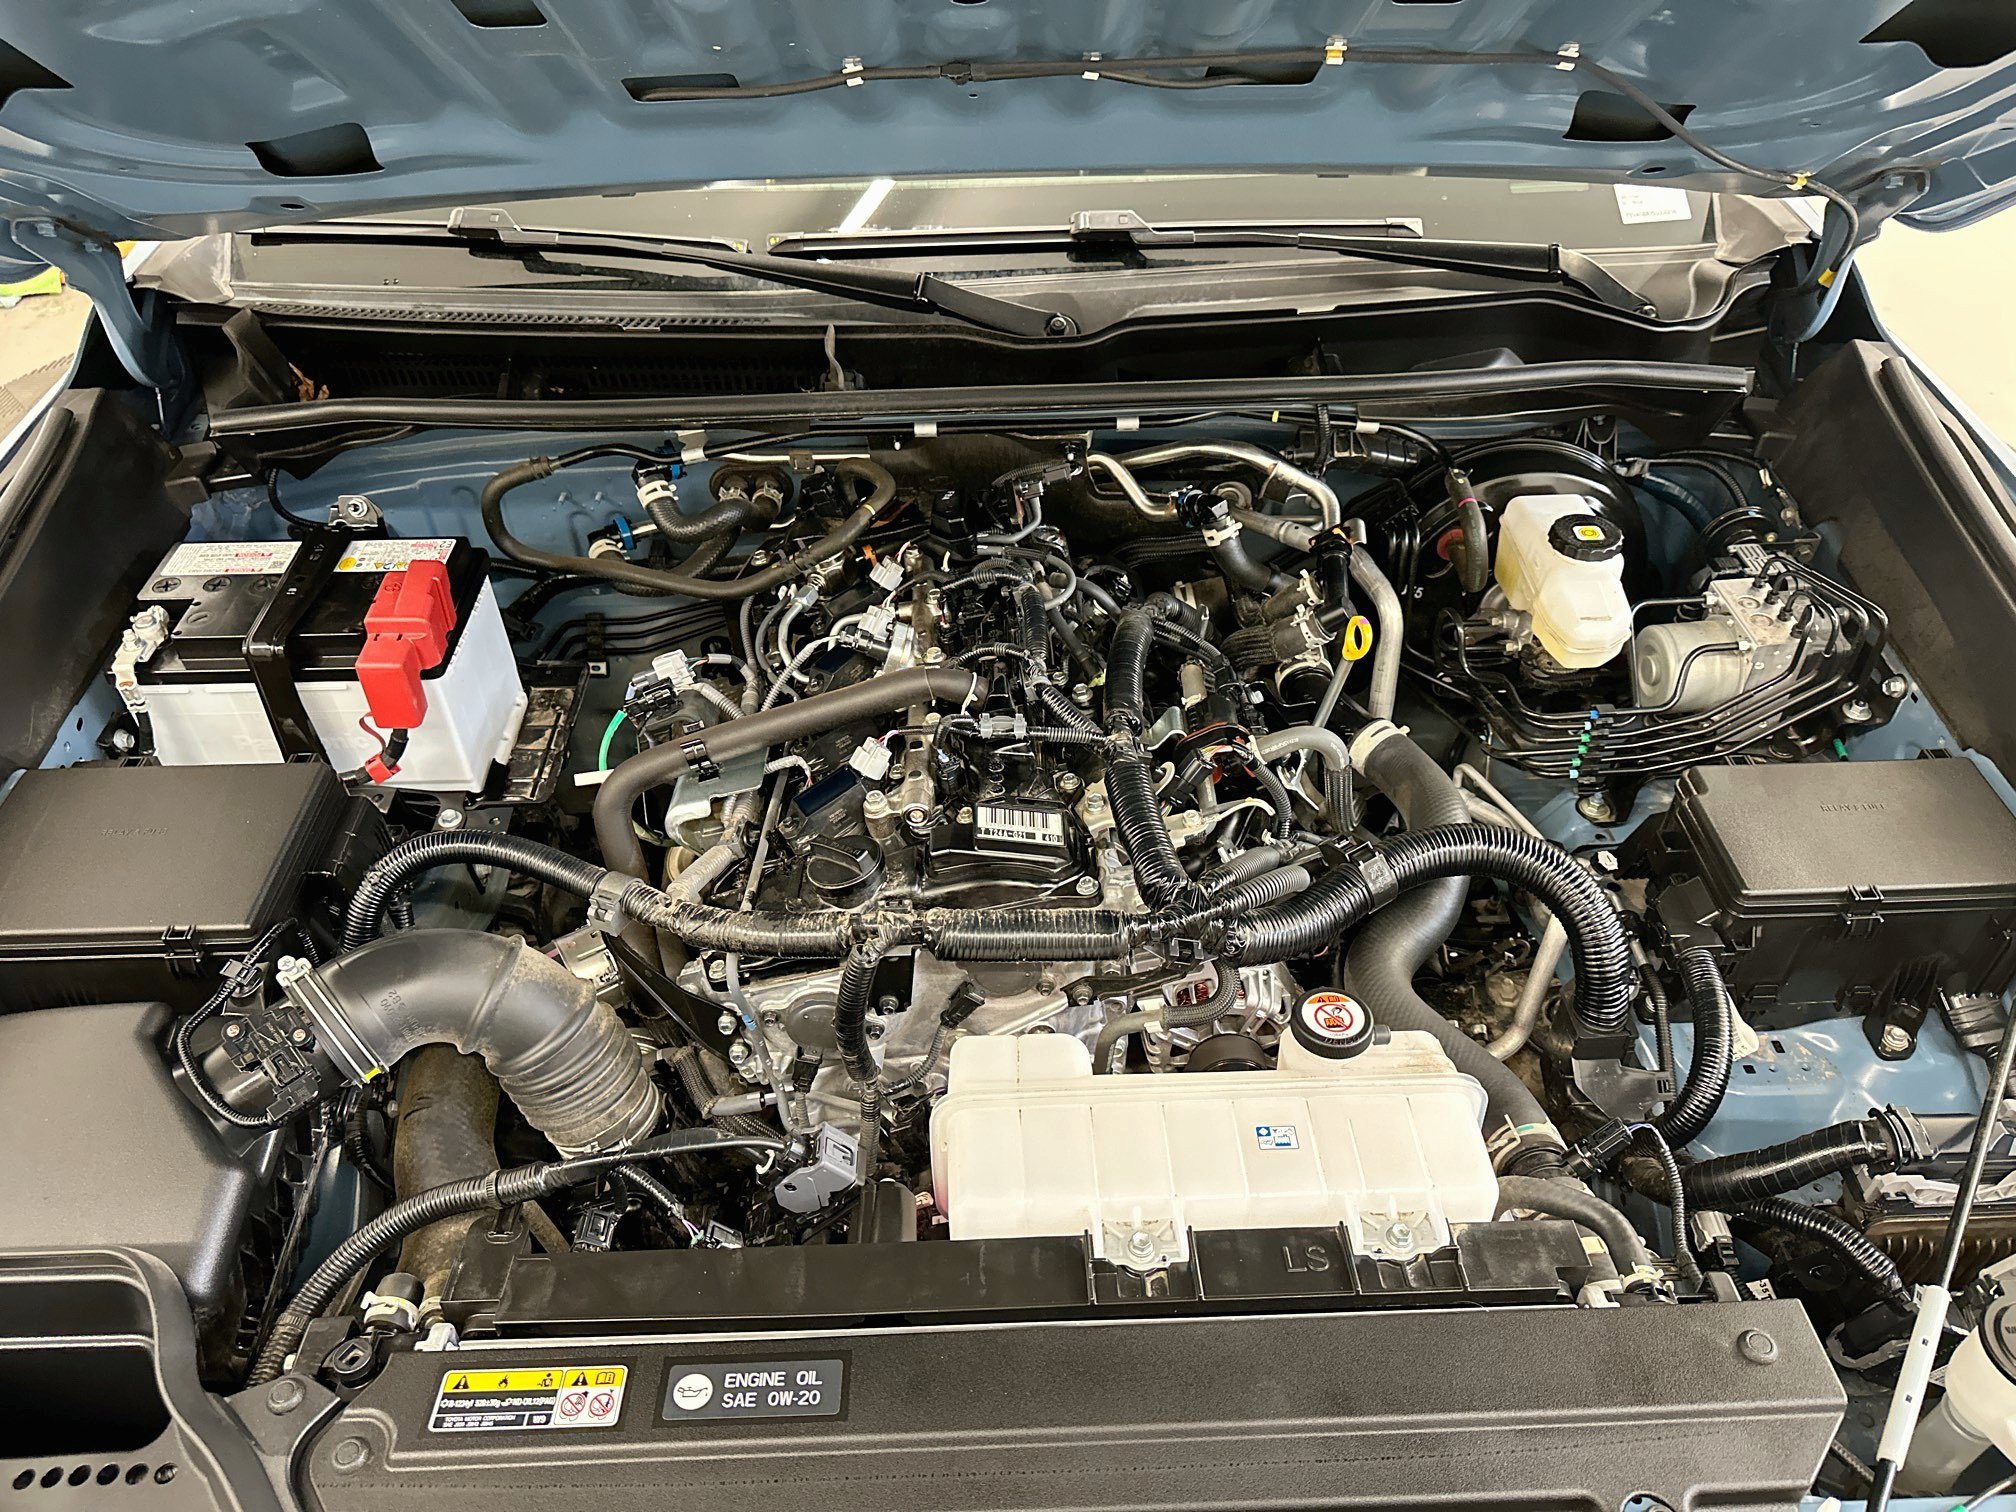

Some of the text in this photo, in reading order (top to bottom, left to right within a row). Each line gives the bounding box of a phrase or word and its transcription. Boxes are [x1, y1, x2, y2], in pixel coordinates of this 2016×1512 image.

[1282, 1245, 1330, 1273] LS
[724, 1370, 823, 1388] ENGINE OIL
[721, 1390, 821, 1409] SAE 0W-20
